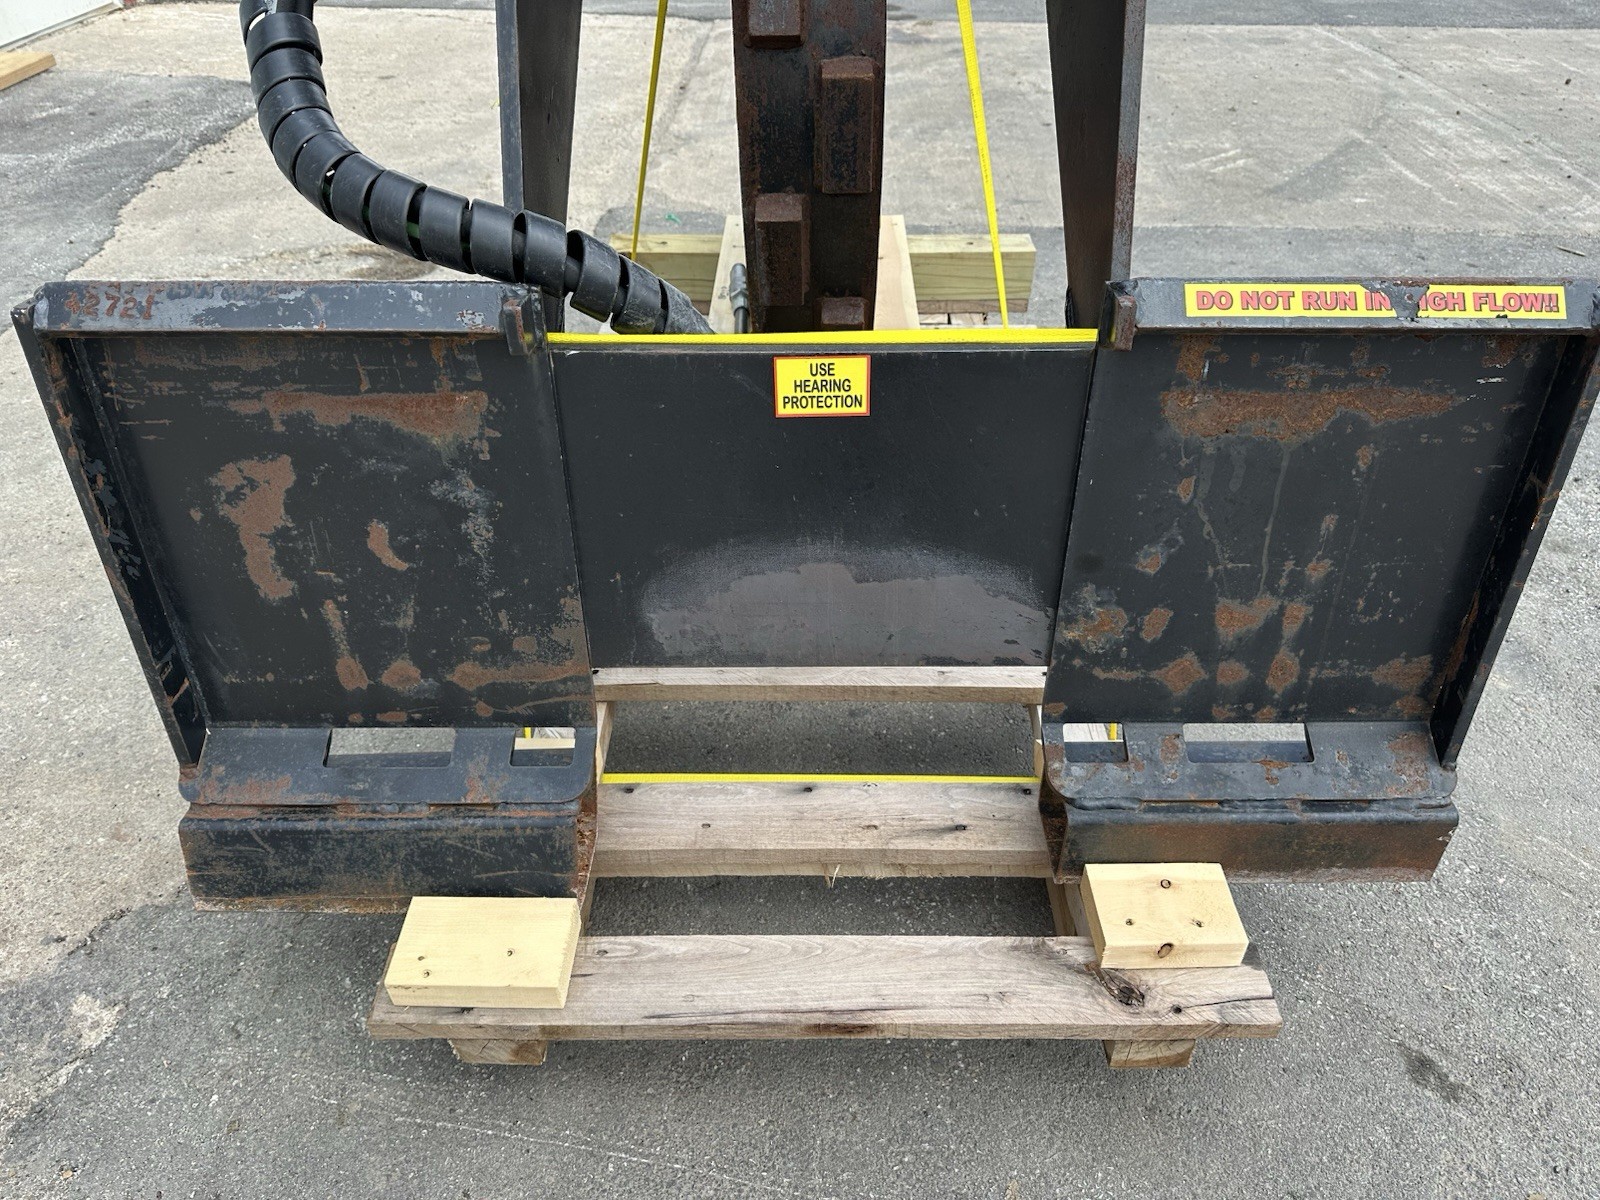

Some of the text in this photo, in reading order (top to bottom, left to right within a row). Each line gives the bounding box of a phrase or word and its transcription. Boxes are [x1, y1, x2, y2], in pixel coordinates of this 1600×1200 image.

[1196, 290, 1233, 310] DO
[1240, 290, 1295, 311] NOT
[1301, 291, 1357, 311] RUN
[1418, 291, 1467, 311] IGH
[1472, 292, 1560, 312] FLOW!!
[809, 362, 836, 377] USE
[793, 378, 851, 393] HEARING
[782, 394, 863, 409] PROTECTION
